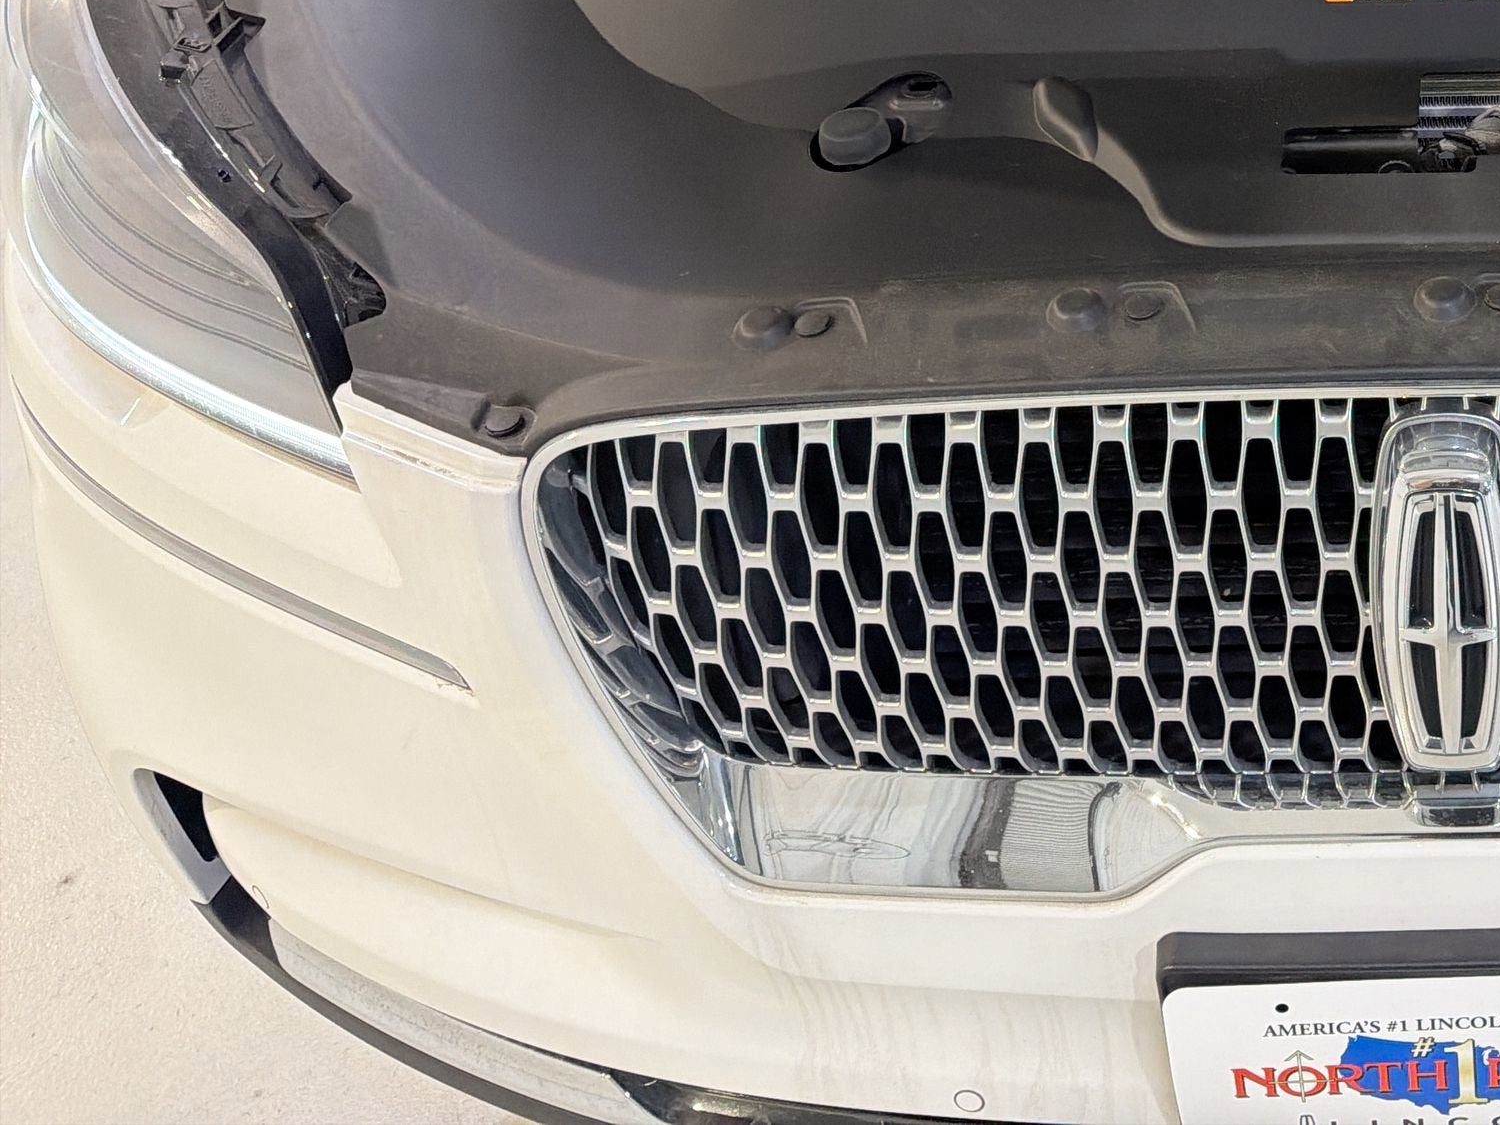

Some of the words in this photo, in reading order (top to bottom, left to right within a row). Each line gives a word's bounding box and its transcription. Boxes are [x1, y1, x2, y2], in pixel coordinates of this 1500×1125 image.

[1263, 1019, 1381, 1037] AMERICA'S
[1386, 1019, 1408, 1033] #1
[1231, 1059, 1449, 1098] NORTH
